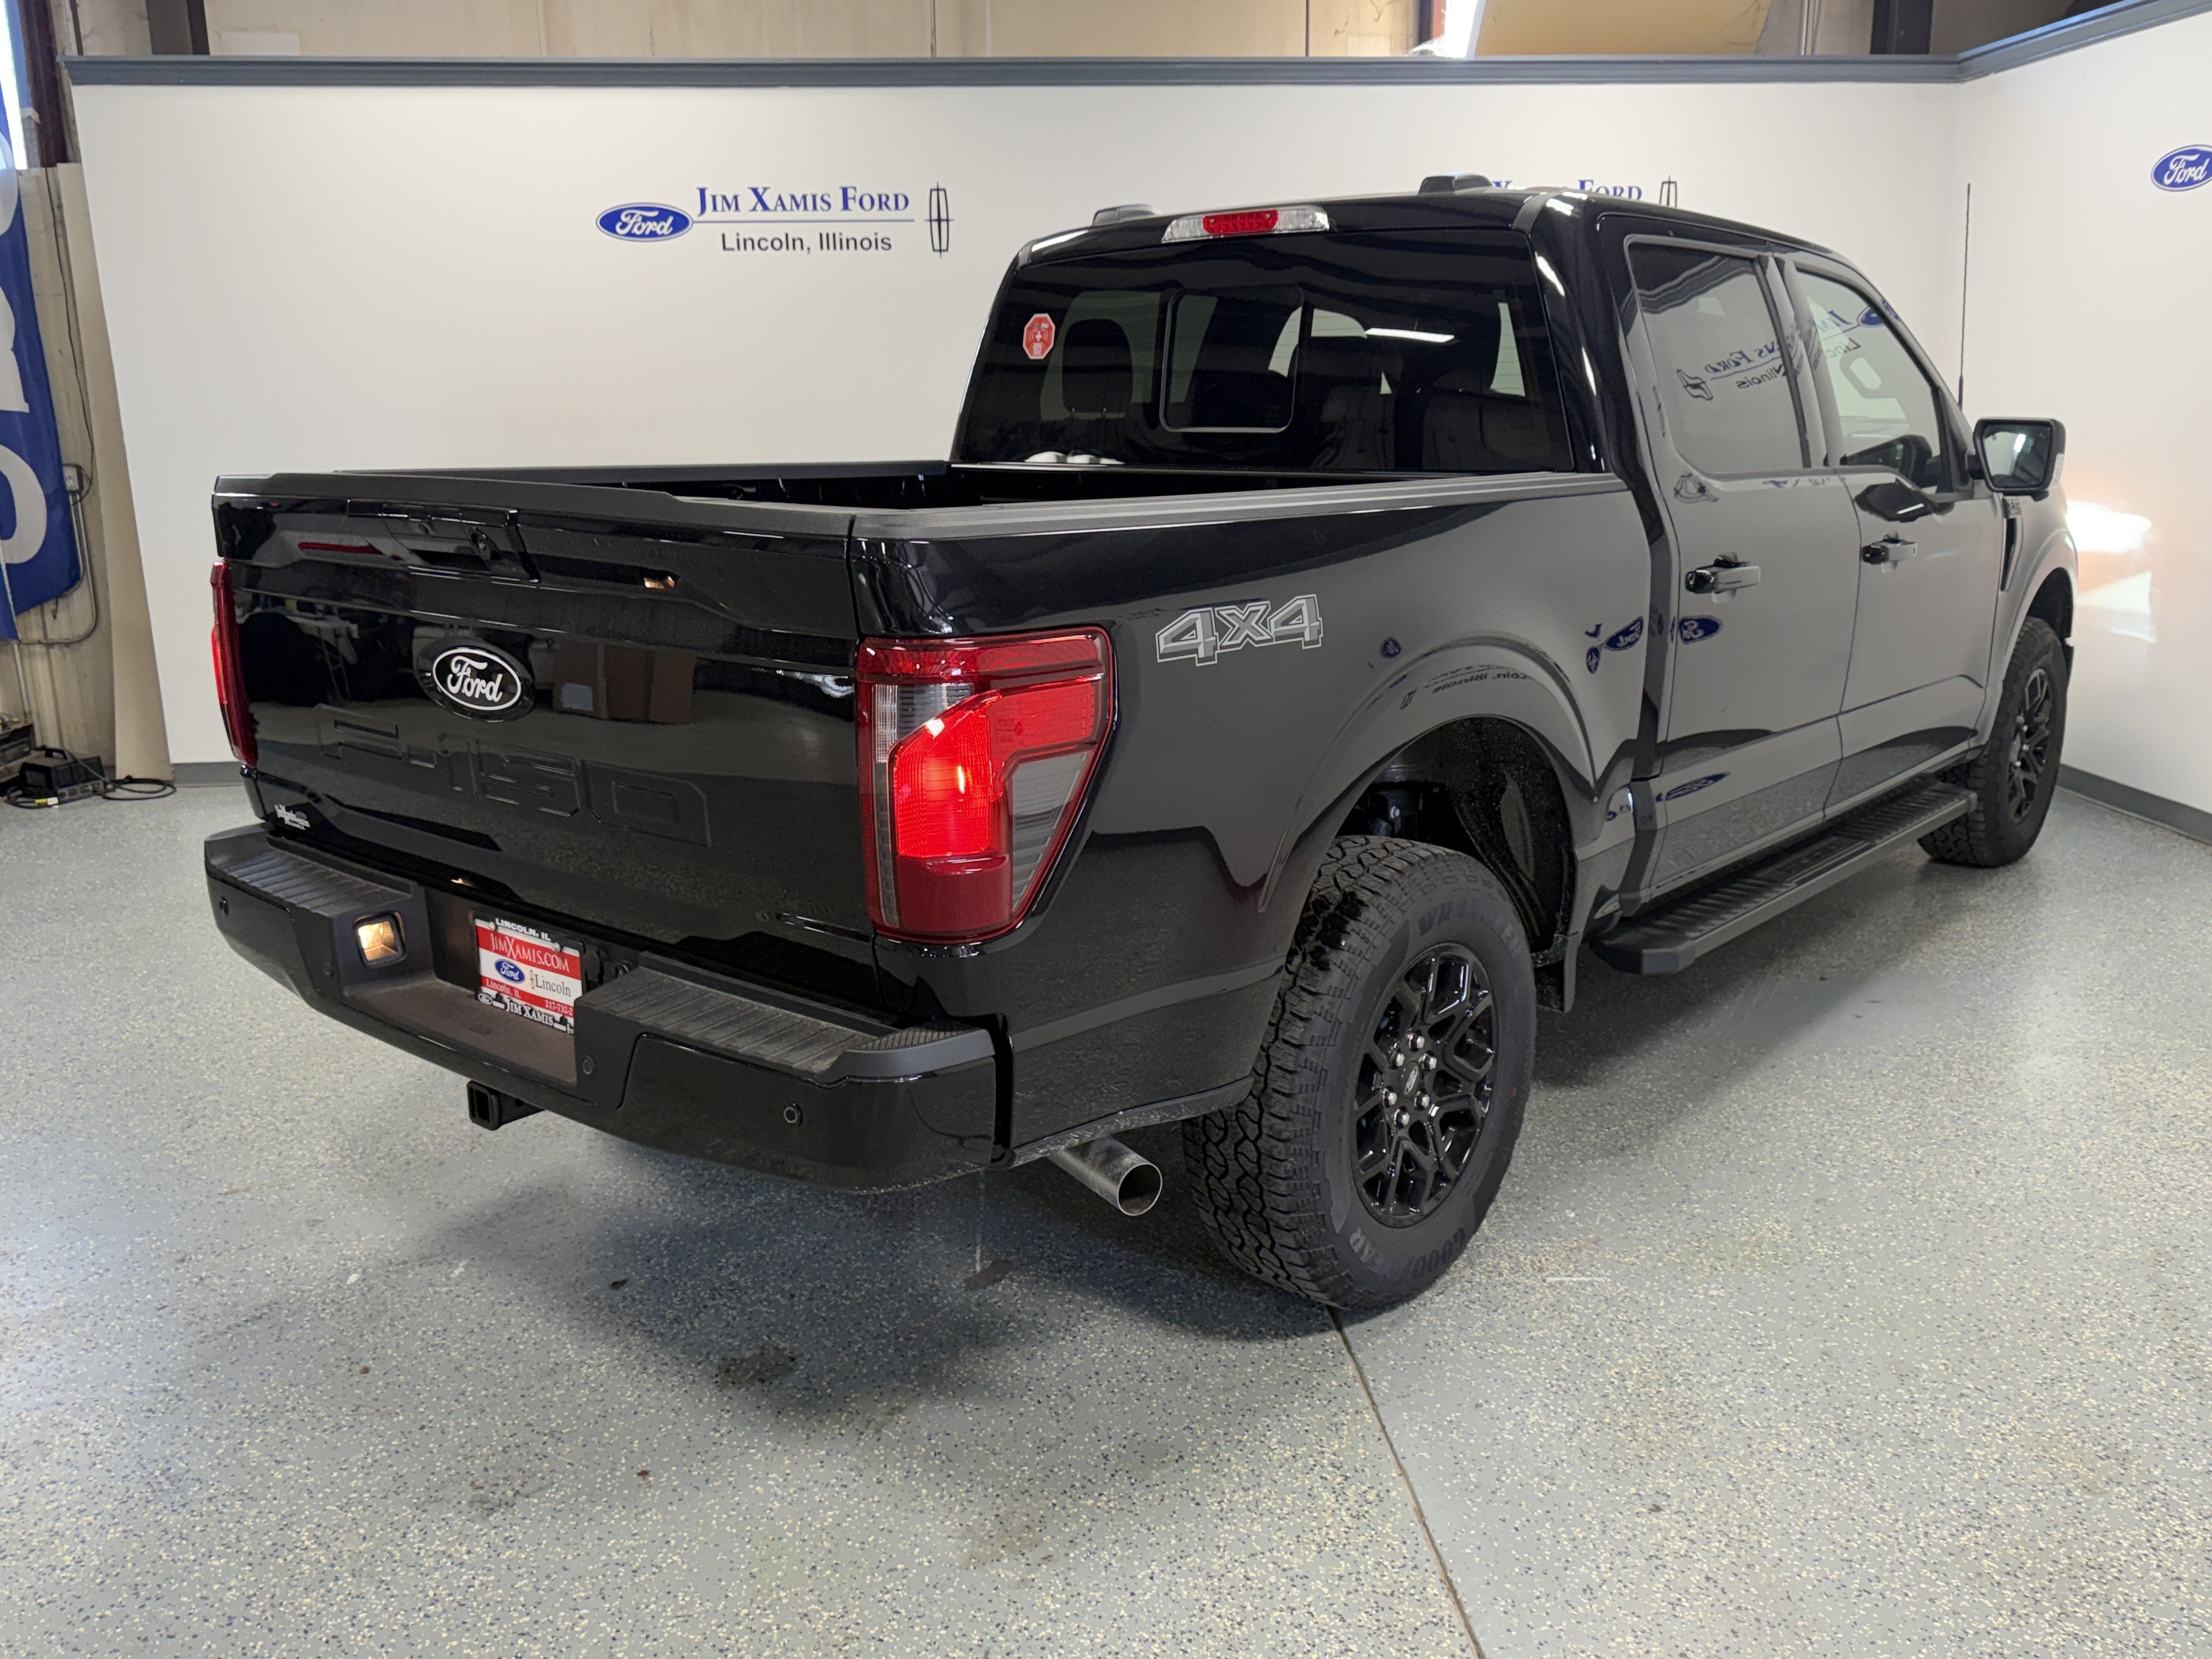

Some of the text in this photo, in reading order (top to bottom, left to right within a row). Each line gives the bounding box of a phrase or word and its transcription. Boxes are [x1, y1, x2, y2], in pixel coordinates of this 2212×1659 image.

[2164, 154, 2210, 185] Ford
[696, 187, 910, 216] JIM XAMIS FORD
[615, 210, 674, 236] Ford
[722, 232, 893, 255] Lincoln, Illinois
[447, 655, 503, 702] Ford
[541, 932, 551, 941] IL
[500, 961, 571, 997] Ford Lincoln
[505, 997, 522, 1015] JIM
[522, 1005, 554, 1027] XAMIS
